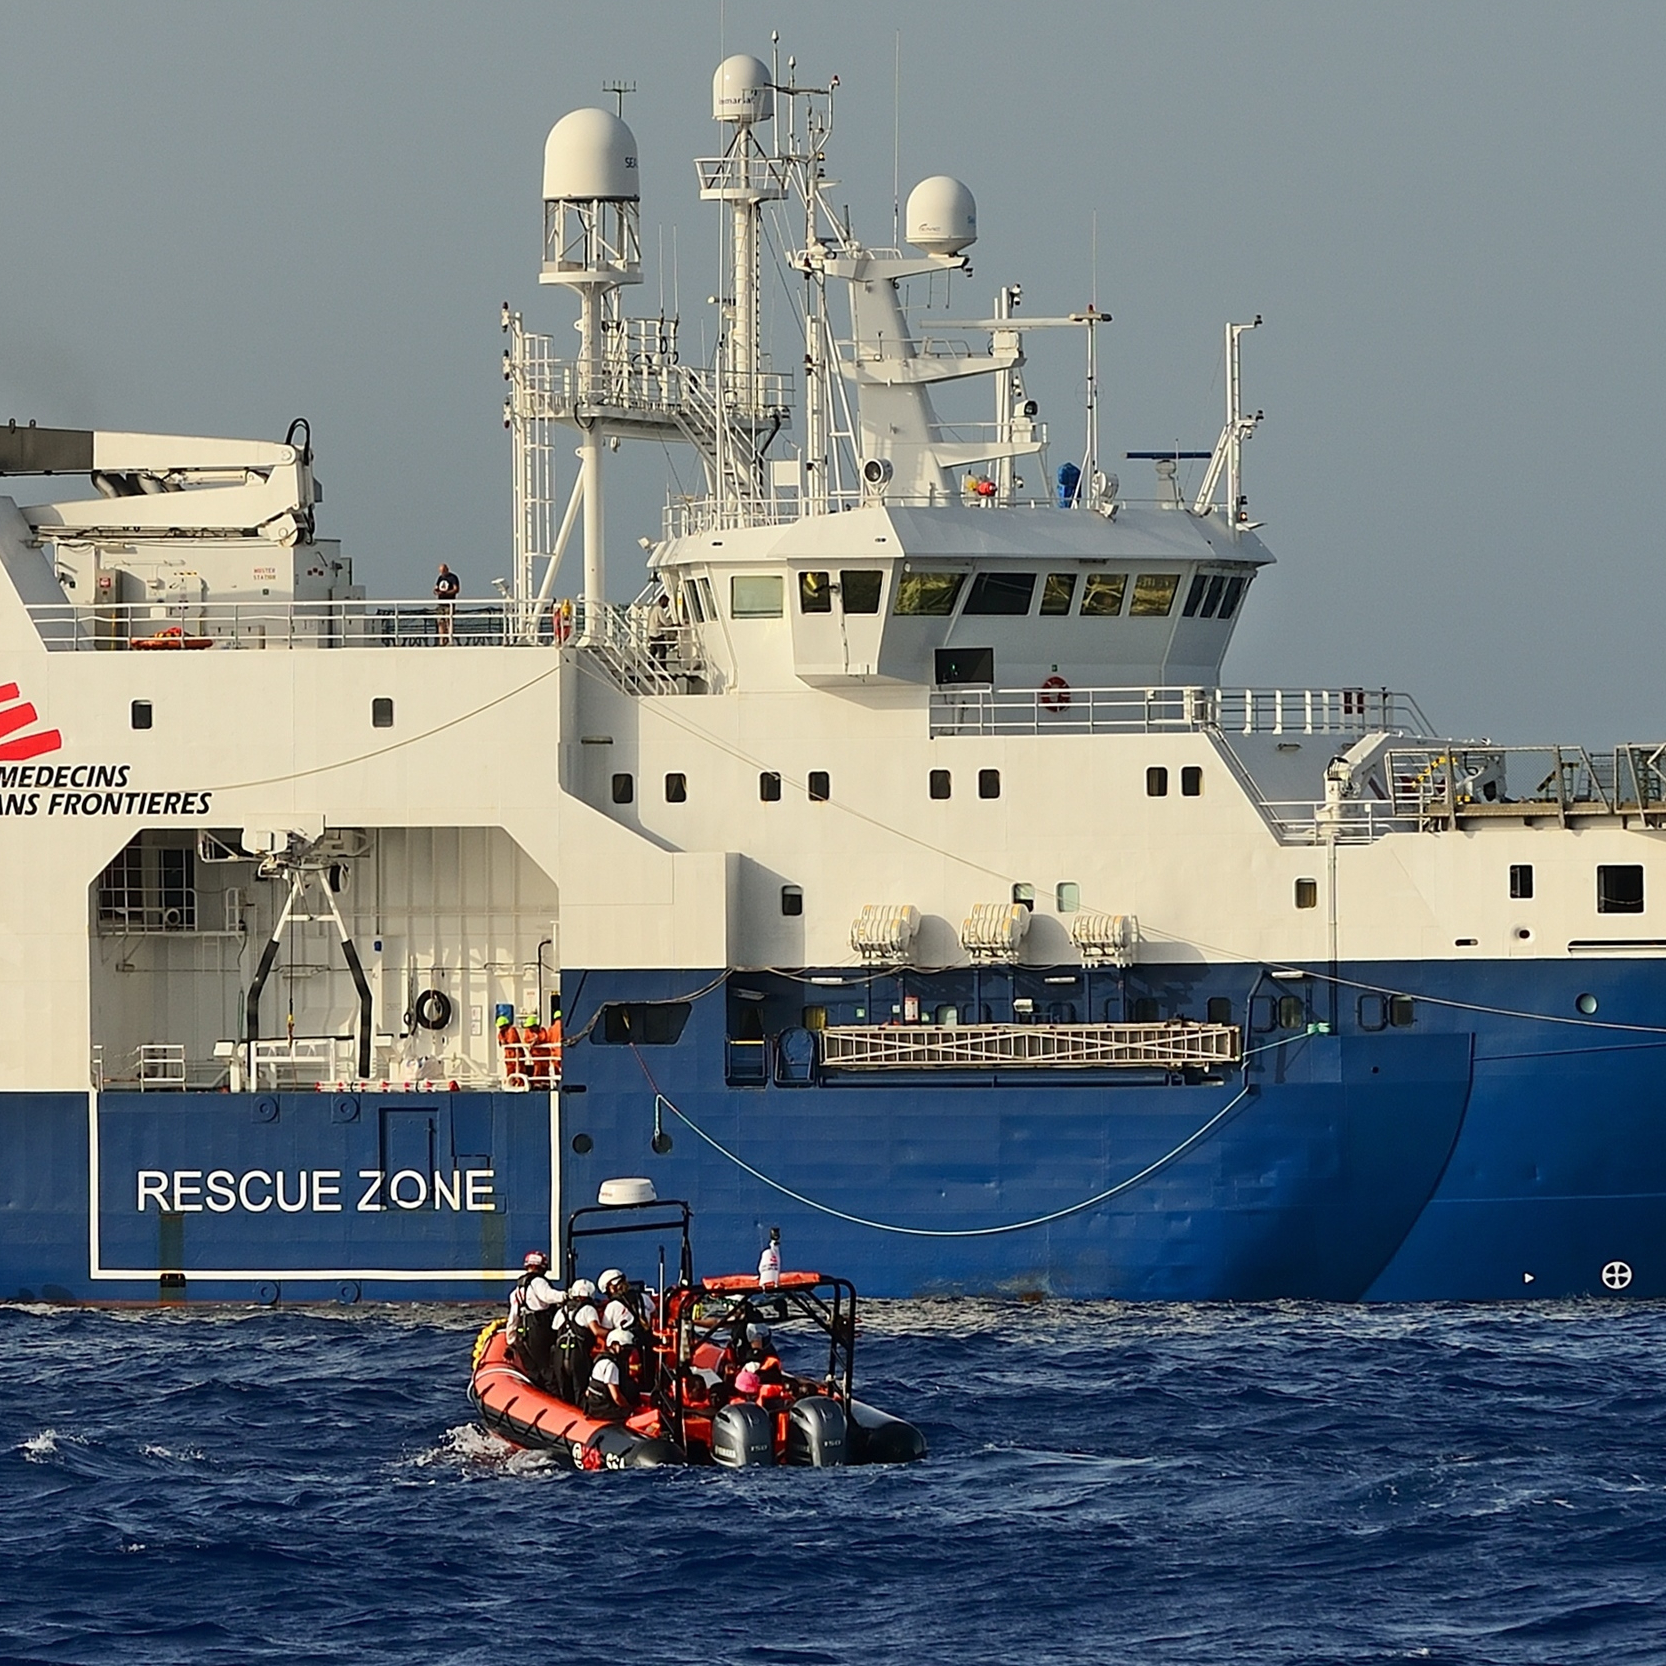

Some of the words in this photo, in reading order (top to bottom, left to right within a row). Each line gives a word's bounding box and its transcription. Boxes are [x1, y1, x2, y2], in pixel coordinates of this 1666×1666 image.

[48, 792, 213, 815] FRONTIERES
[138, 1169, 342, 1213] RESCUE
[357, 1169, 496, 1211] ZONE
